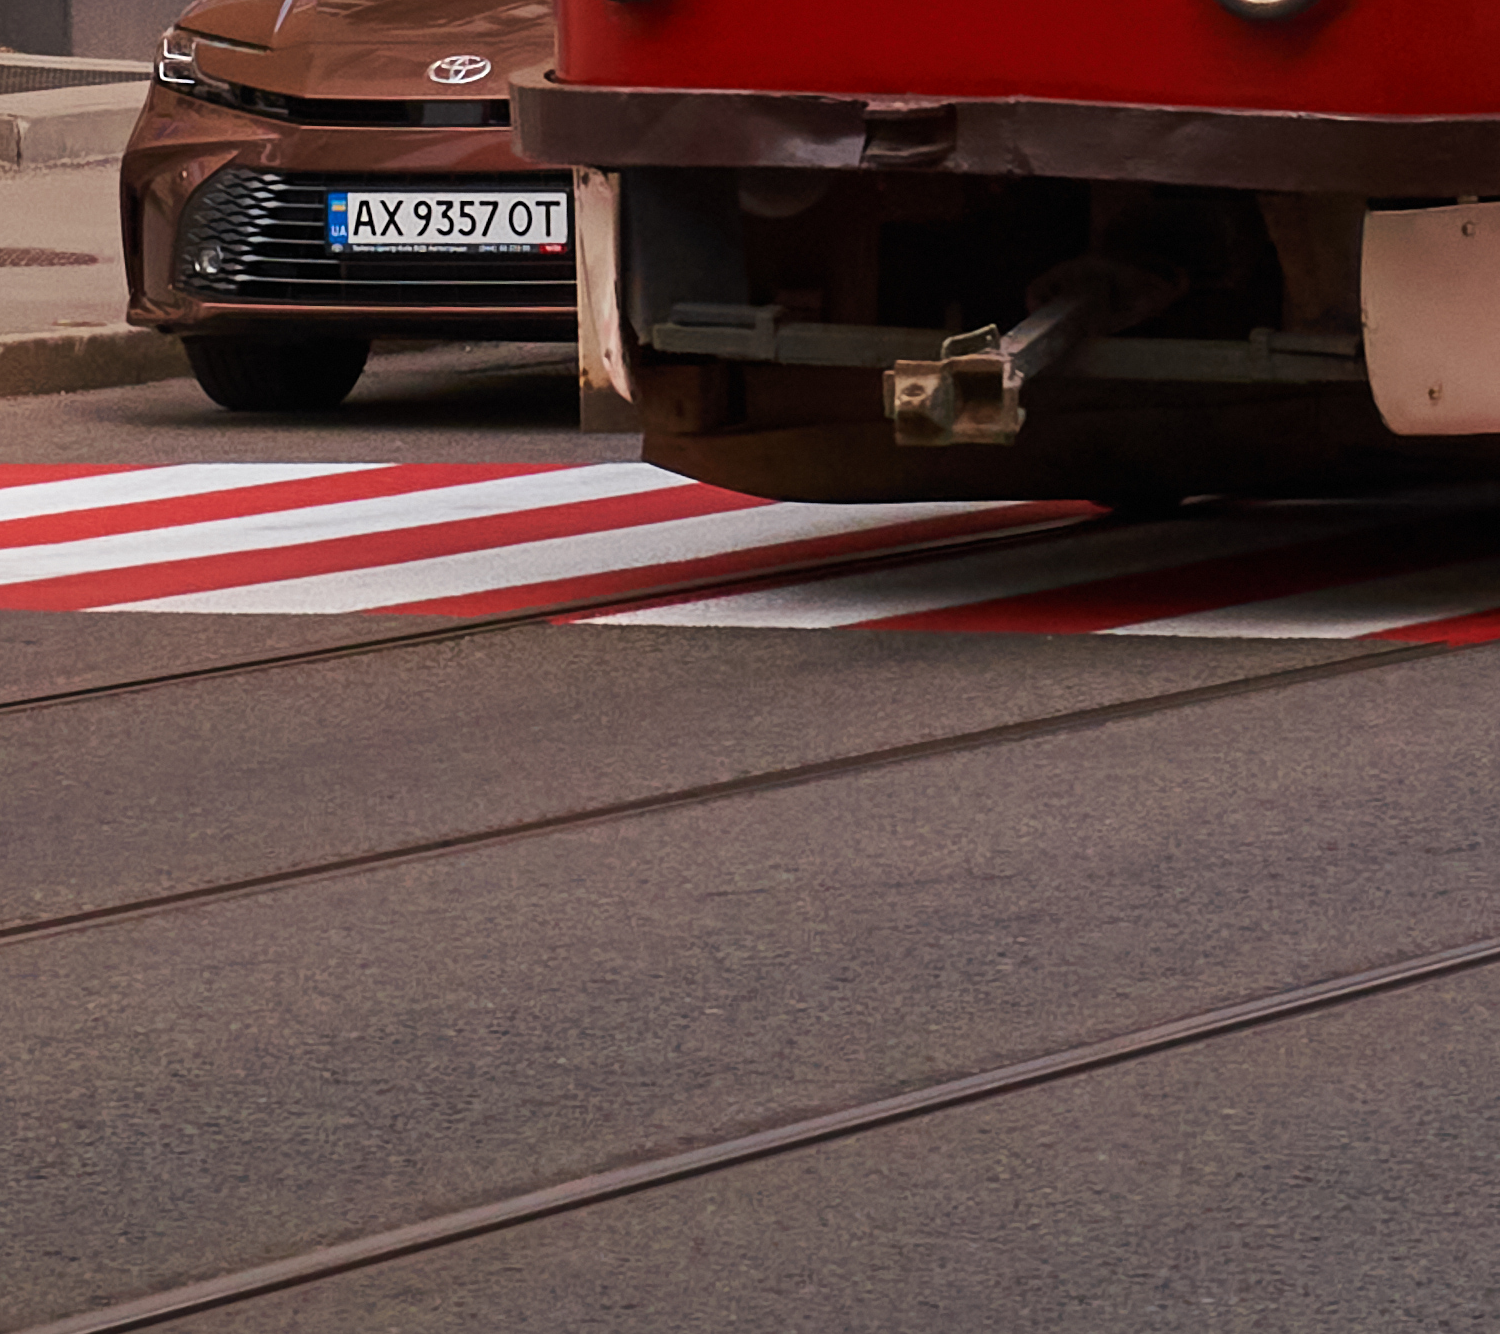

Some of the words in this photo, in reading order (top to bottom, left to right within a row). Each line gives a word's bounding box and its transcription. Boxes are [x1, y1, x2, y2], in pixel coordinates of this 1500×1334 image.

[353, 199, 404, 237] AX
[413, 199, 499, 237] 9357
[508, 199, 561, 237] OT
